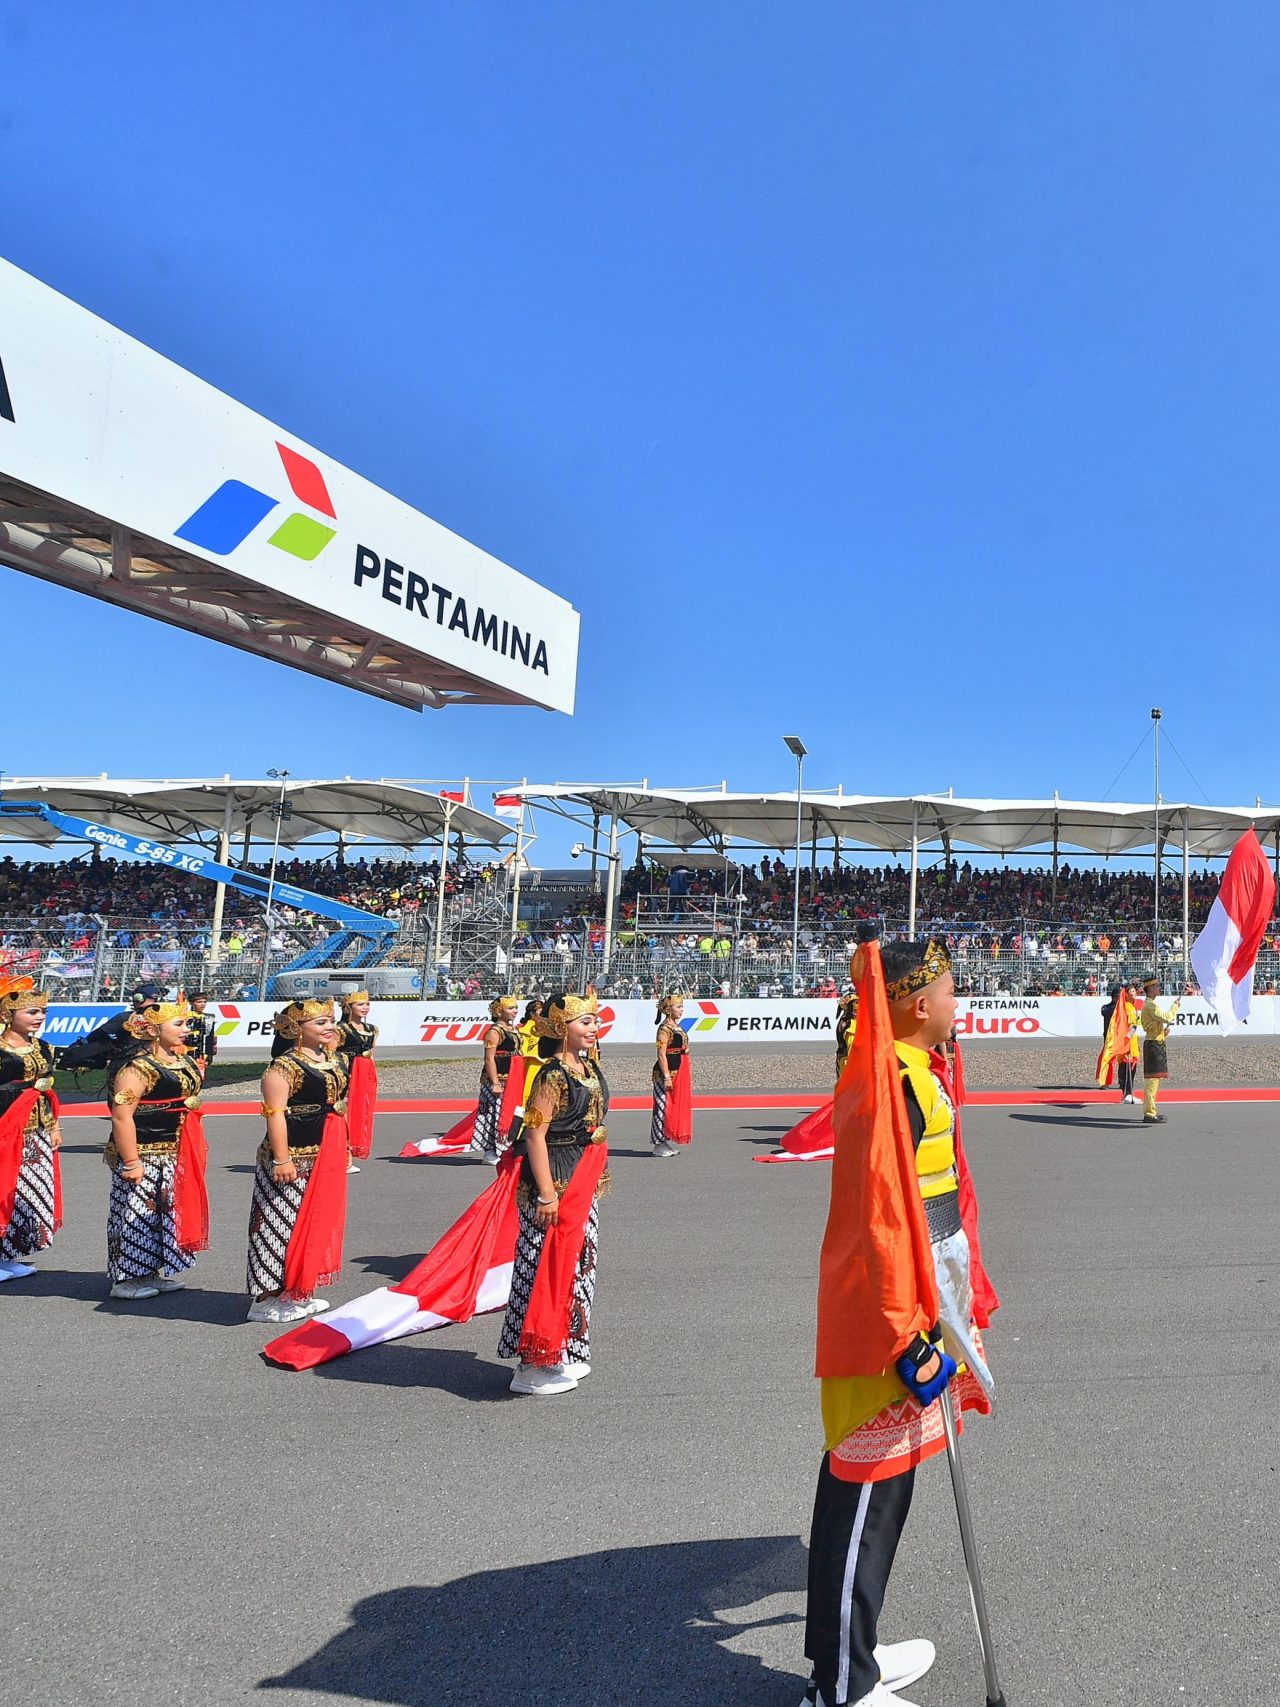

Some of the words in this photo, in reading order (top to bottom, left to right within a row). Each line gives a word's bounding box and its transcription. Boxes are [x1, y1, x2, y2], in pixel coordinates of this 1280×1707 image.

[353, 543, 550, 676] PERTAMINA
[84, 824, 128, 849] Genie
[134, 840, 177, 864] S-85
[175, 856, 204, 873] XC
[970, 1000, 1040, 1010] PERTAMINA
[423, 1015, 494, 1023] PERTAMA
[727, 1016, 832, 1031] PERTAMINA
